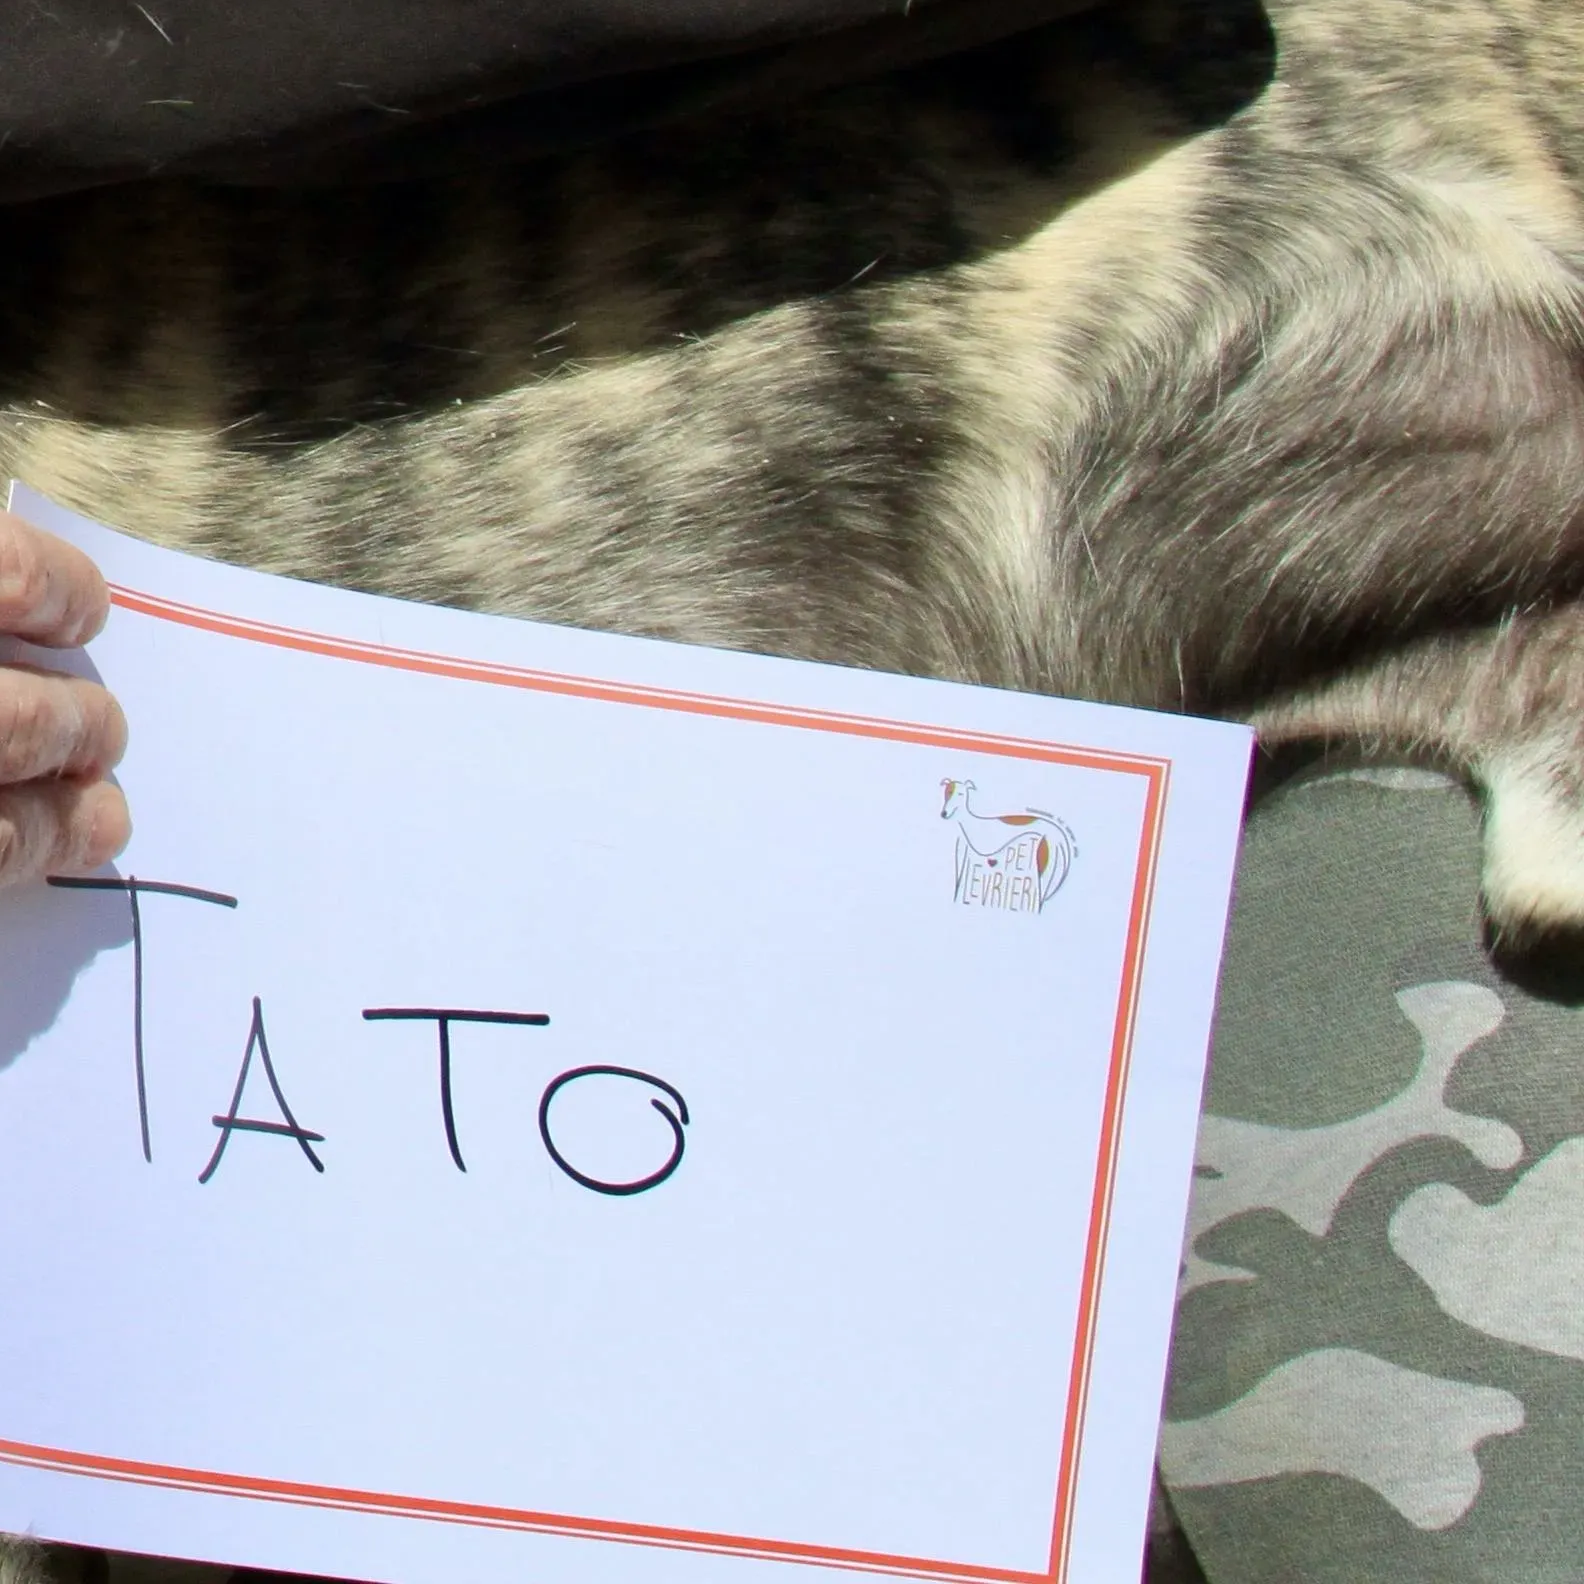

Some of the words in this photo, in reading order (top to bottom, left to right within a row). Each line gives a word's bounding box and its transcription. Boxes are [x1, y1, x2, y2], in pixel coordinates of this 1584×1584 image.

[1004, 837, 1038, 871] PET
[962, 857, 1037, 912] LEVRIERI
[46, 874, 690, 1196] TATO
